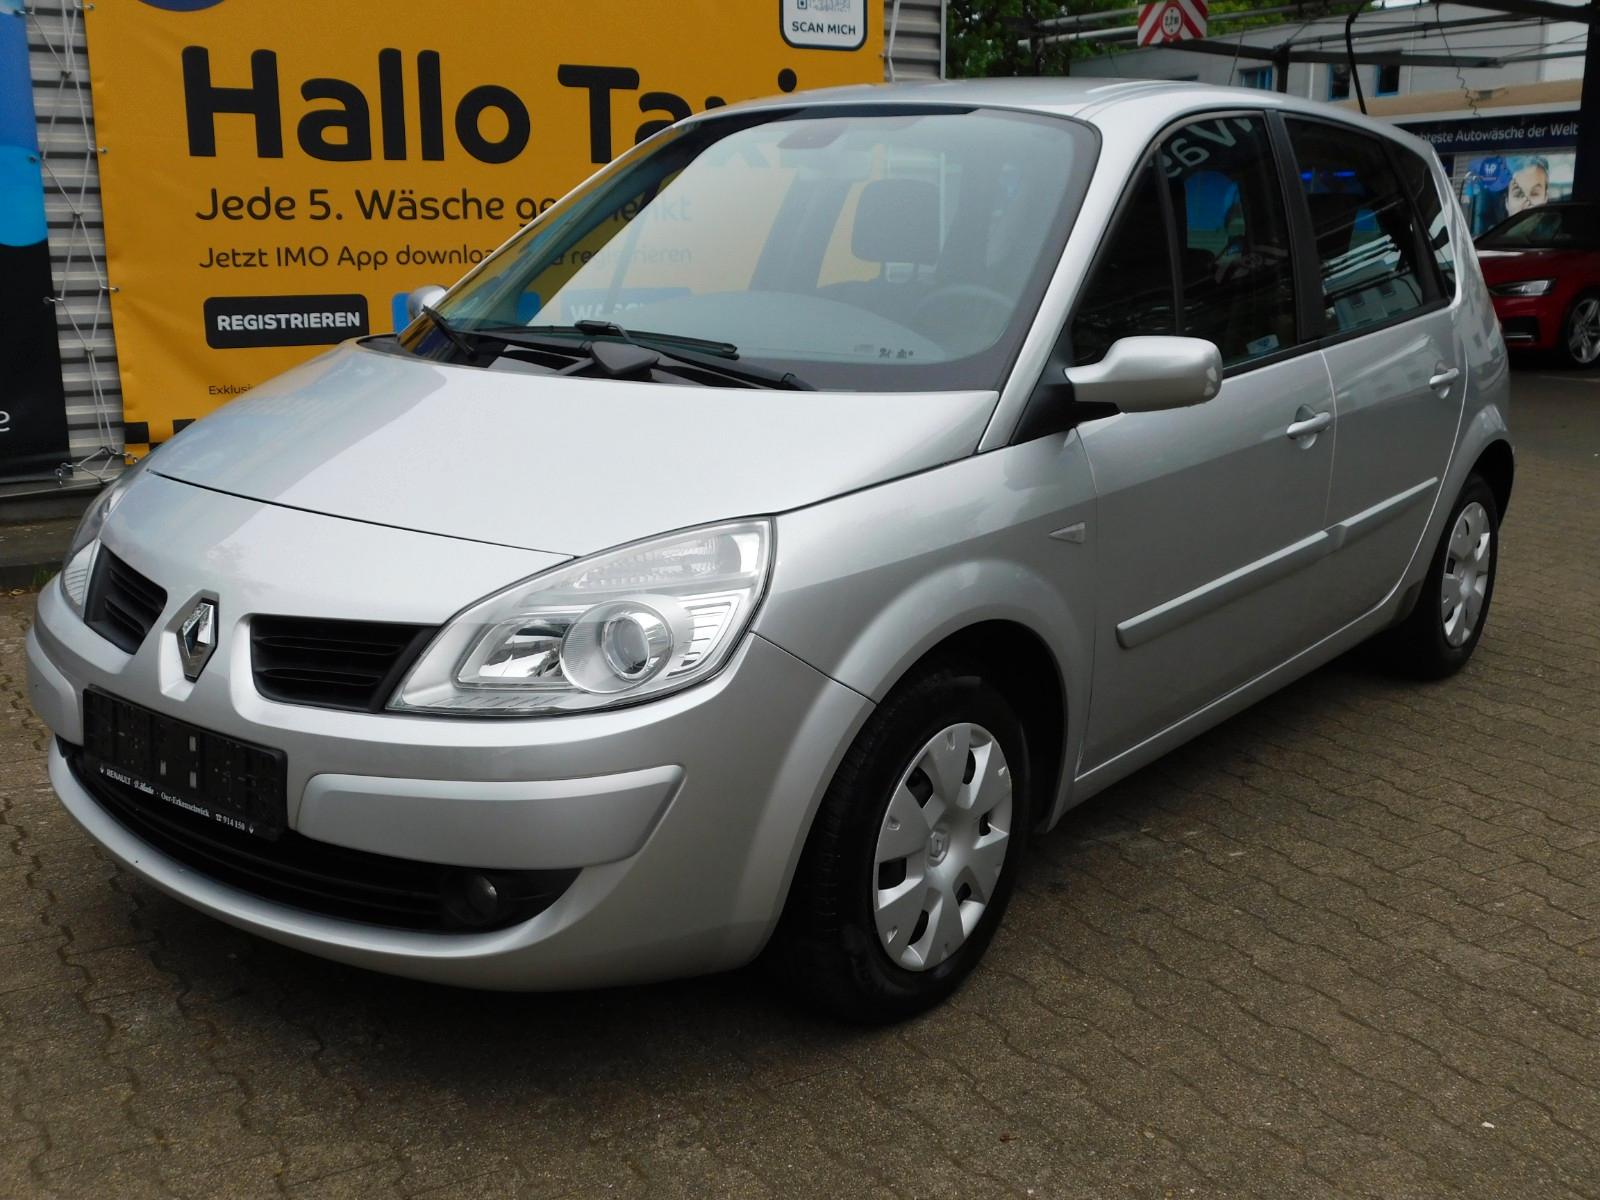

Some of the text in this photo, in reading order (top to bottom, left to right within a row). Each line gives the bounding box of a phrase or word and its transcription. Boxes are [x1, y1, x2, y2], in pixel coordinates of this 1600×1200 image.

[792, 21, 856, 35] SCAN MICH
[181, 45, 531, 164] Hallo
[1455, 126, 1524, 143] Autowäsche
[1527, 125, 1546, 138] der
[1550, 122, 1579, 137] Welt
[195, 186, 297, 221] Jede
[308, 188, 343, 221] 5.
[354, 187, 504, 221] Wäsche
[199, 247, 269, 268] Jetzt
[276, 246, 329, 267] IMO
[337, 246, 388, 271] App
[217, 312, 361, 331] REGISTRIEREN
[106, 768, 131, 785] RENAULT
